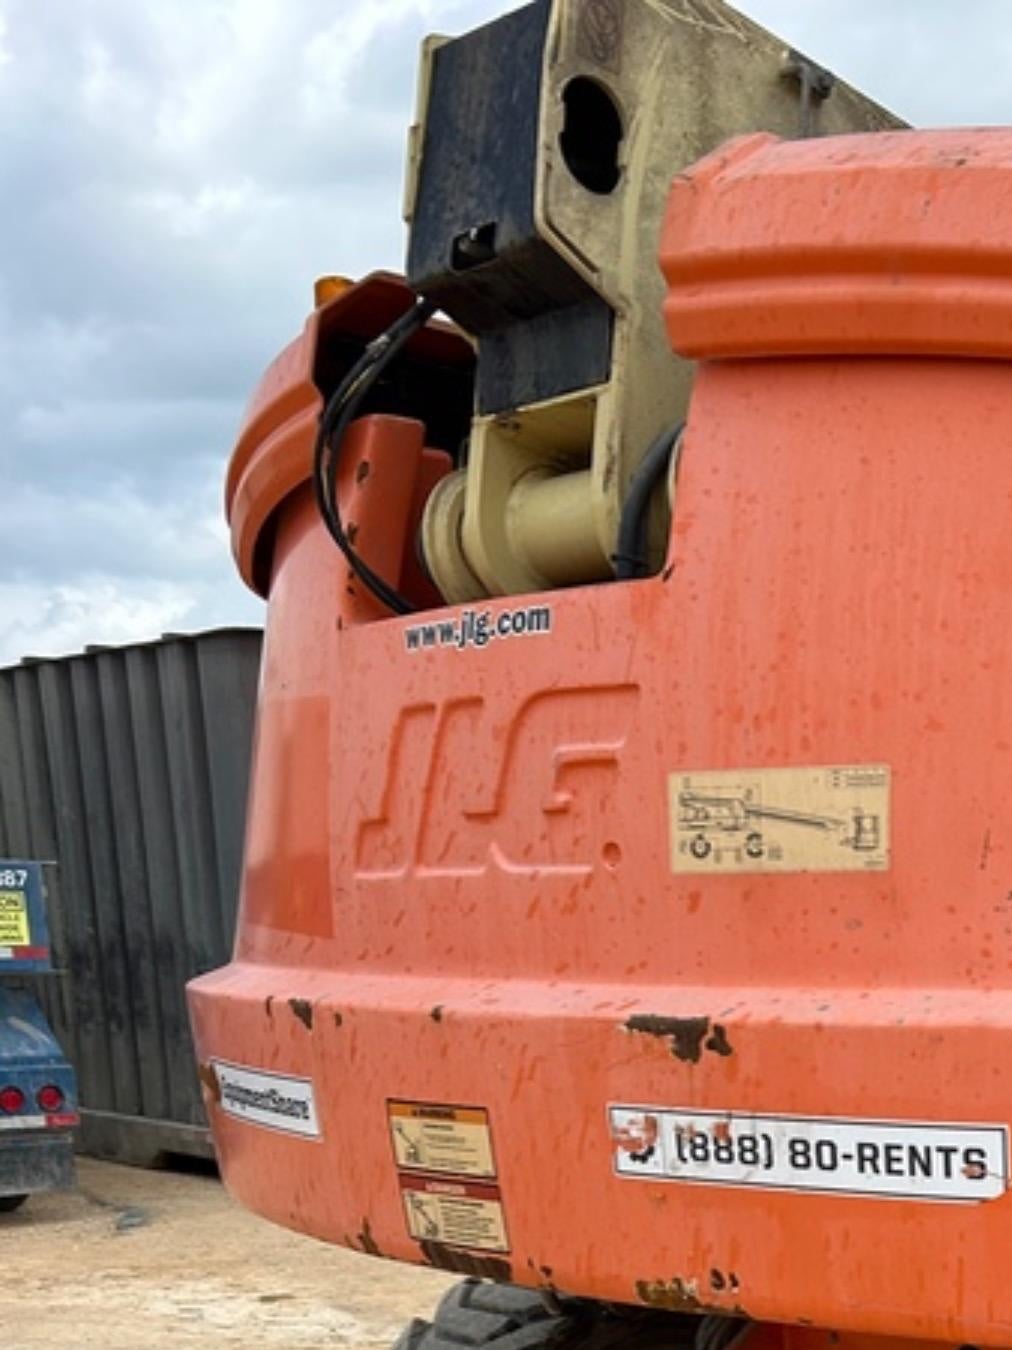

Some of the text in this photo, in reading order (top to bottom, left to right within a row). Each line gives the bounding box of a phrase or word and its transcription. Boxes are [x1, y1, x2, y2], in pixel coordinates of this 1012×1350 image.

[405, 607, 551, 649] www.jlg.com
[353, 684, 640, 878] JLG
[674, 1130, 989, 1180] (888) 80-RENTS
